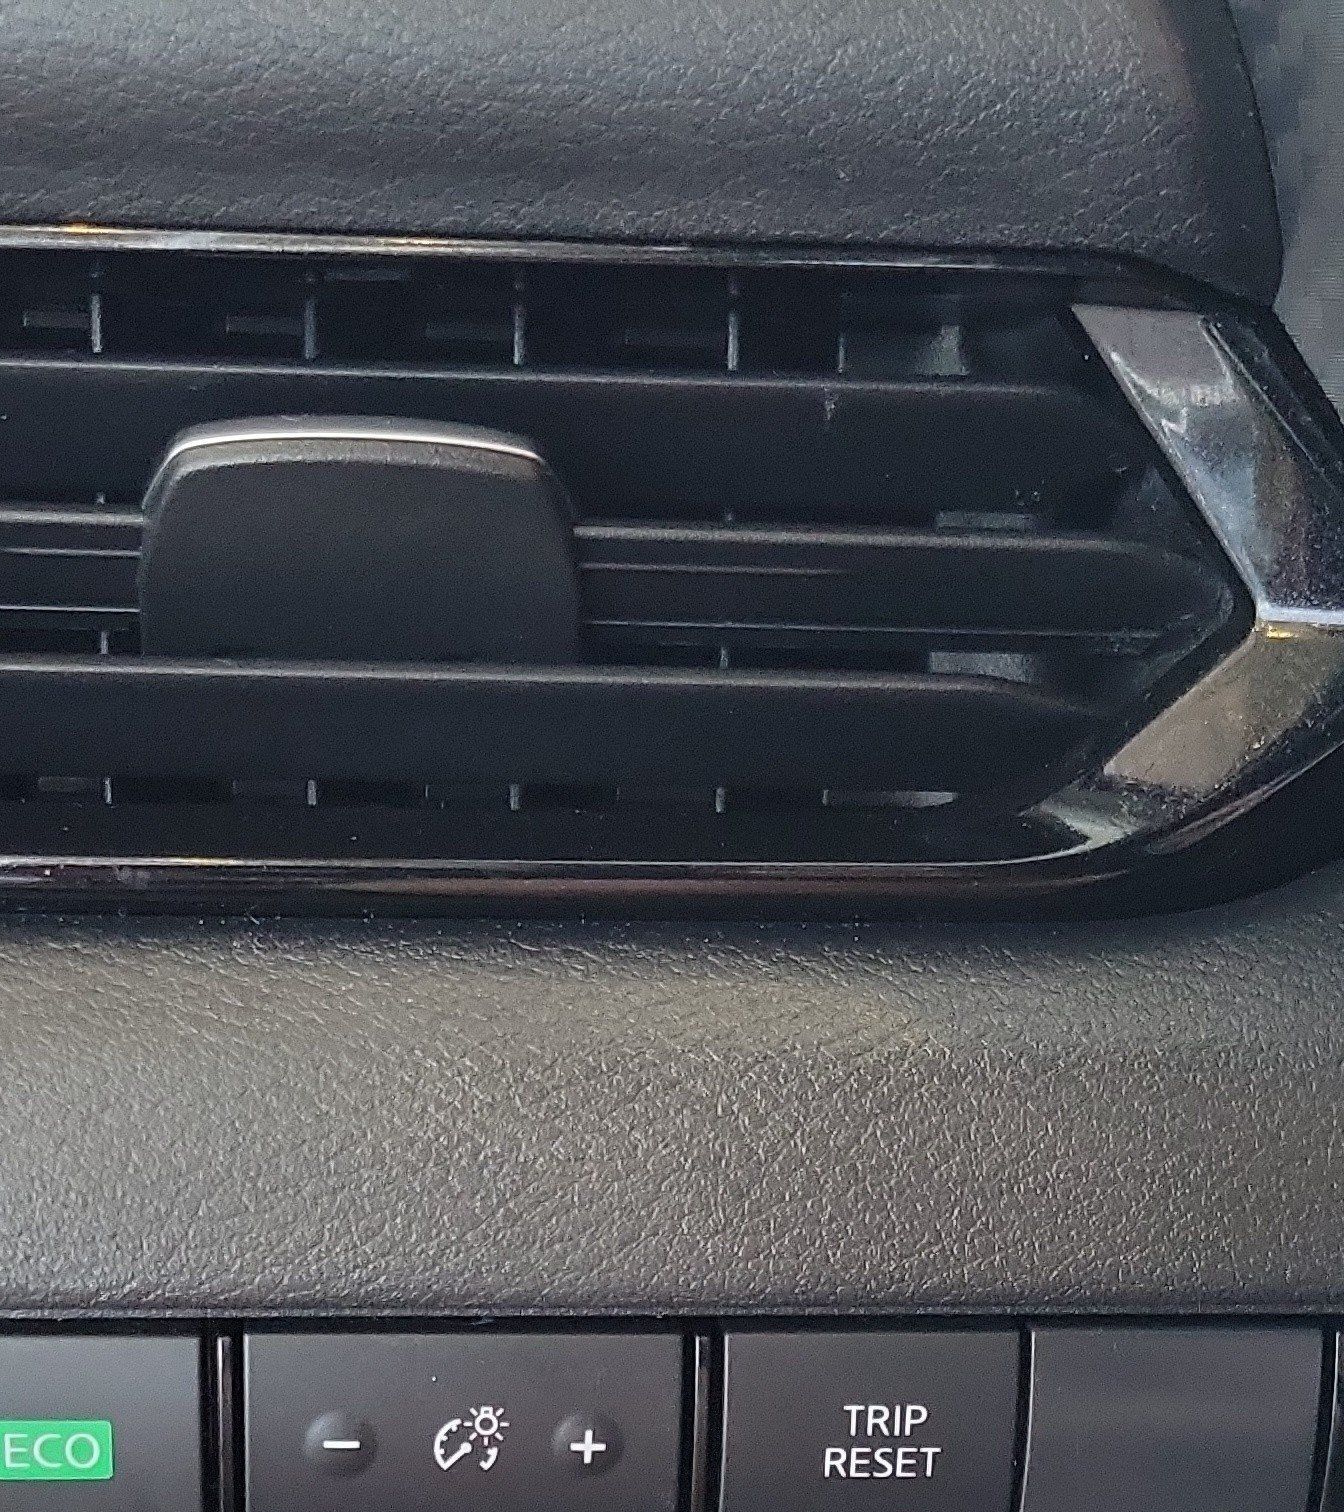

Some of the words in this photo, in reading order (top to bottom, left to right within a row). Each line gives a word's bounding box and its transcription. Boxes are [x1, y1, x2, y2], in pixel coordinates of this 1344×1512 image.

[842, 1403, 929, 1438] TRIP
[2, 1432, 101, 1470] ECO
[823, 1446, 943, 1479] RESET
